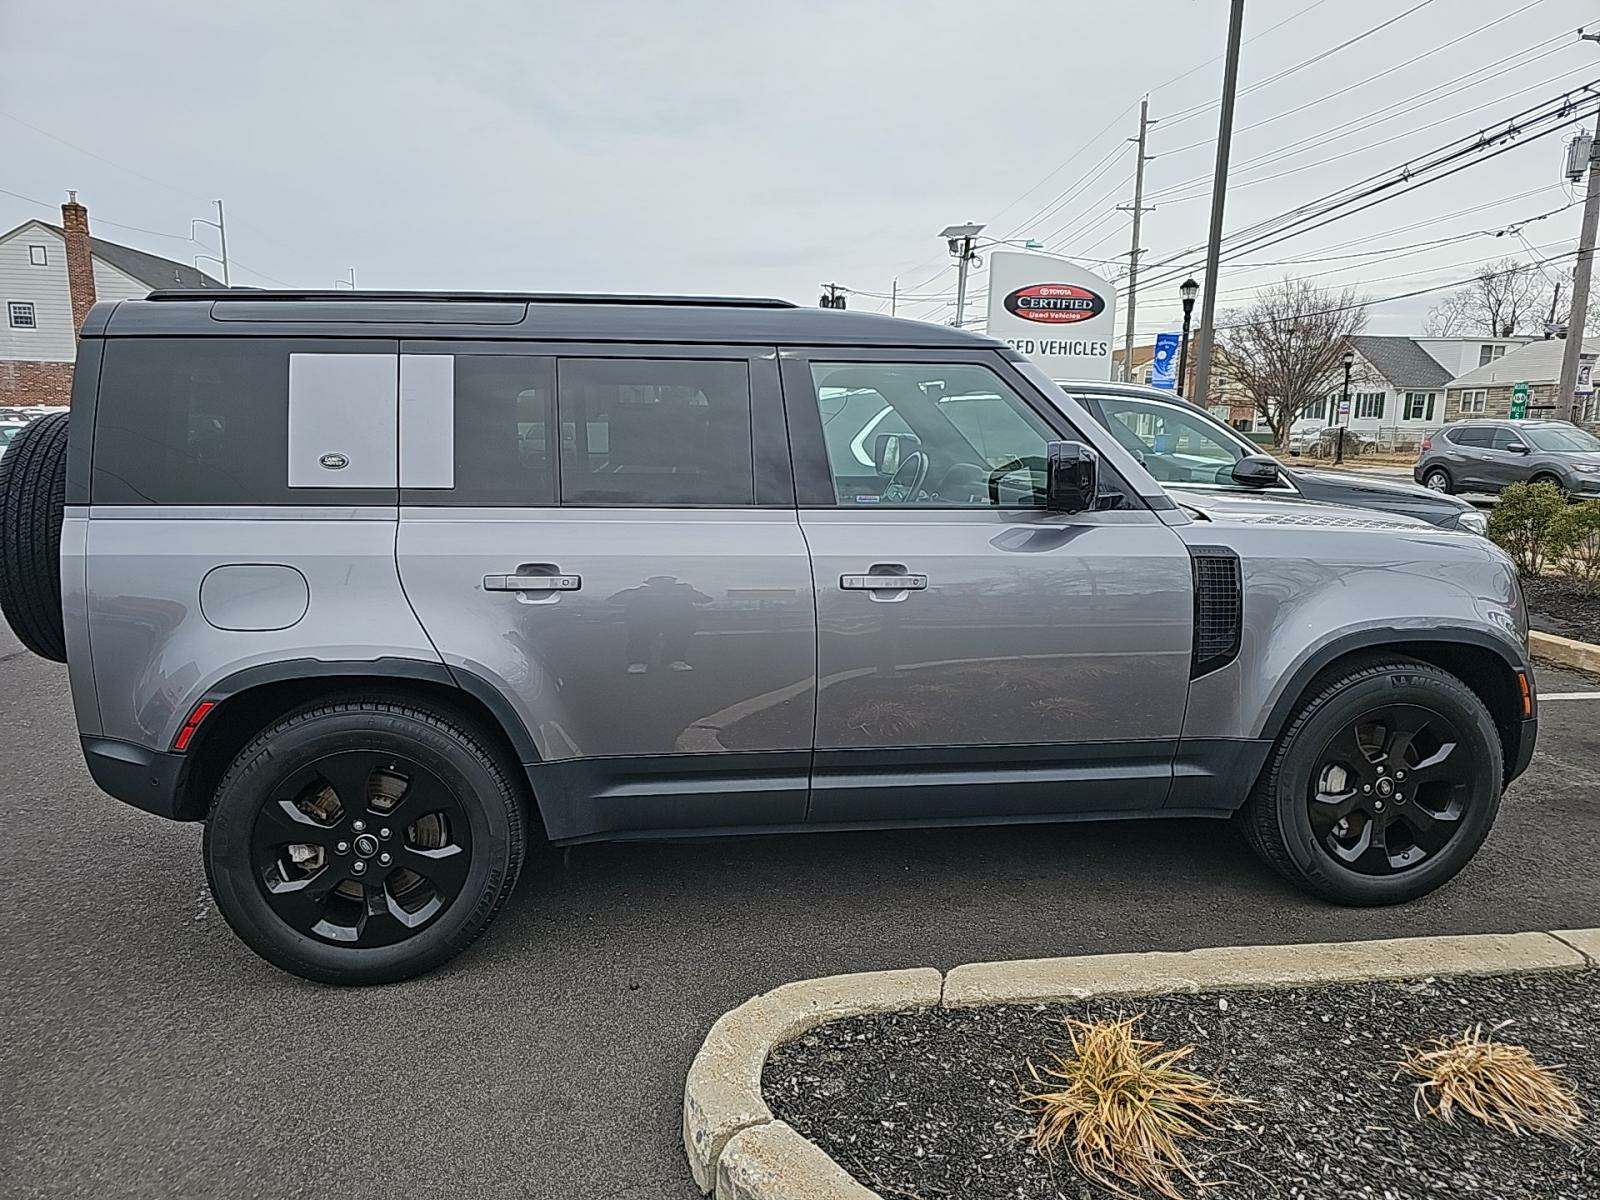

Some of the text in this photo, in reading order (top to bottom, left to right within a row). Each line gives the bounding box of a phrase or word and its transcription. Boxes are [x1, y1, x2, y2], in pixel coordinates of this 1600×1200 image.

[1049, 288, 1072, 296] TOYOTA
[1017, 296, 1093, 310] CERTIFIED
[1050, 311, 1081, 319] Vehicles
[1007, 339, 1108, 356] ED VEHICLES
